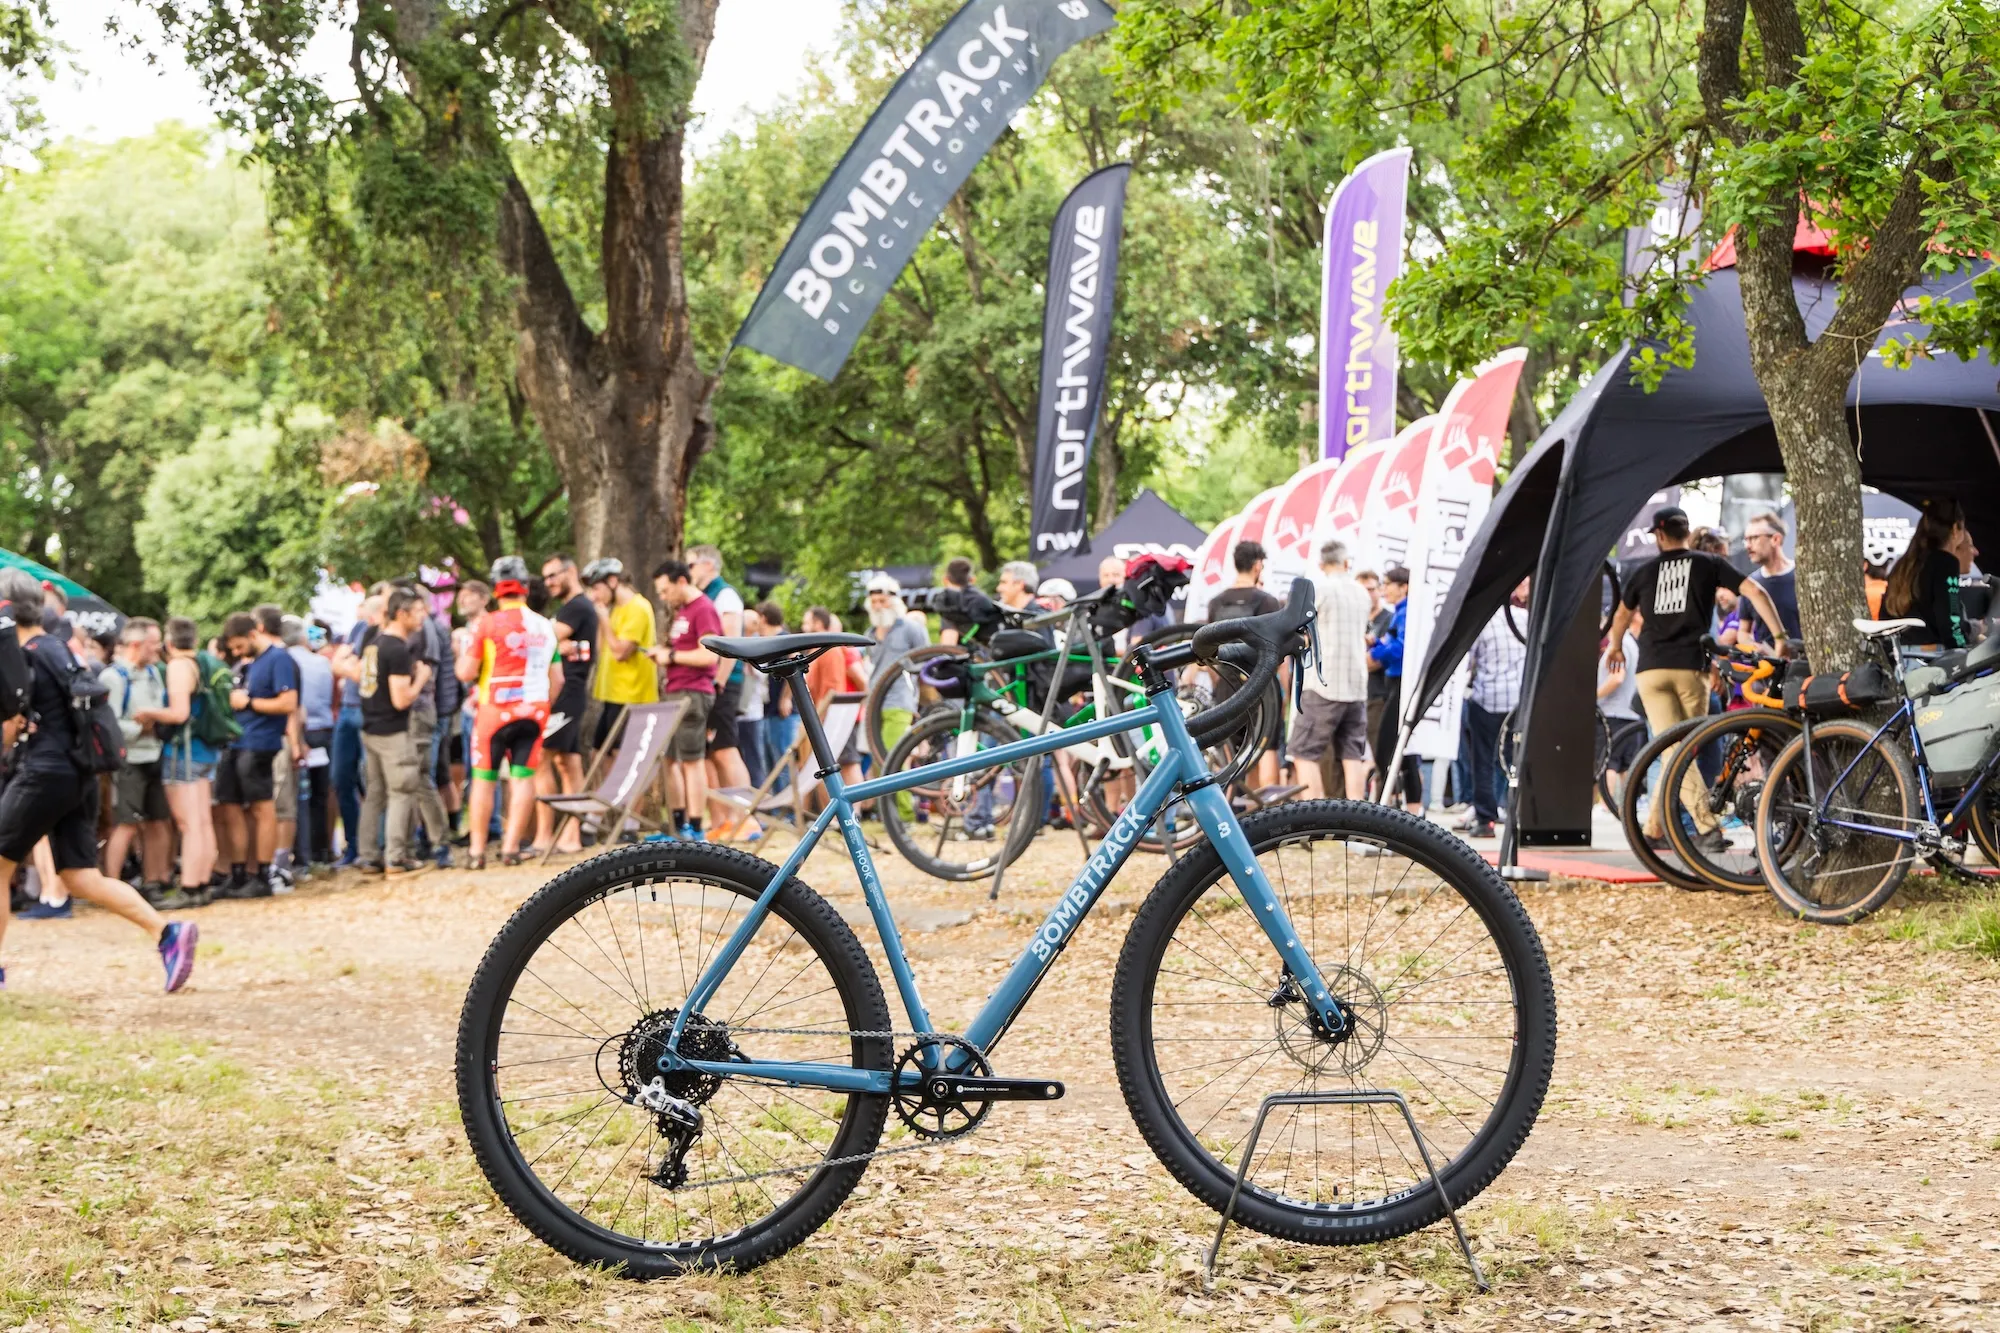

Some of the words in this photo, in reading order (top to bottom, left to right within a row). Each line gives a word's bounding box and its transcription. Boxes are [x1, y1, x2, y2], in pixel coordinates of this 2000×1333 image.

[783, 4, 1030, 320] BOMBTRACK
[823, 191, 924, 336] BICYCLE
[932, 42, 1041, 175] COMPANY
[1052, 204, 1106, 511] northwave
[1345, 219, 1379, 461] orthwave
[609, 859, 676, 879] WTB
[855, 849, 873, 880] HOOK
[1031, 803, 1147, 963] BOMBTRACK
